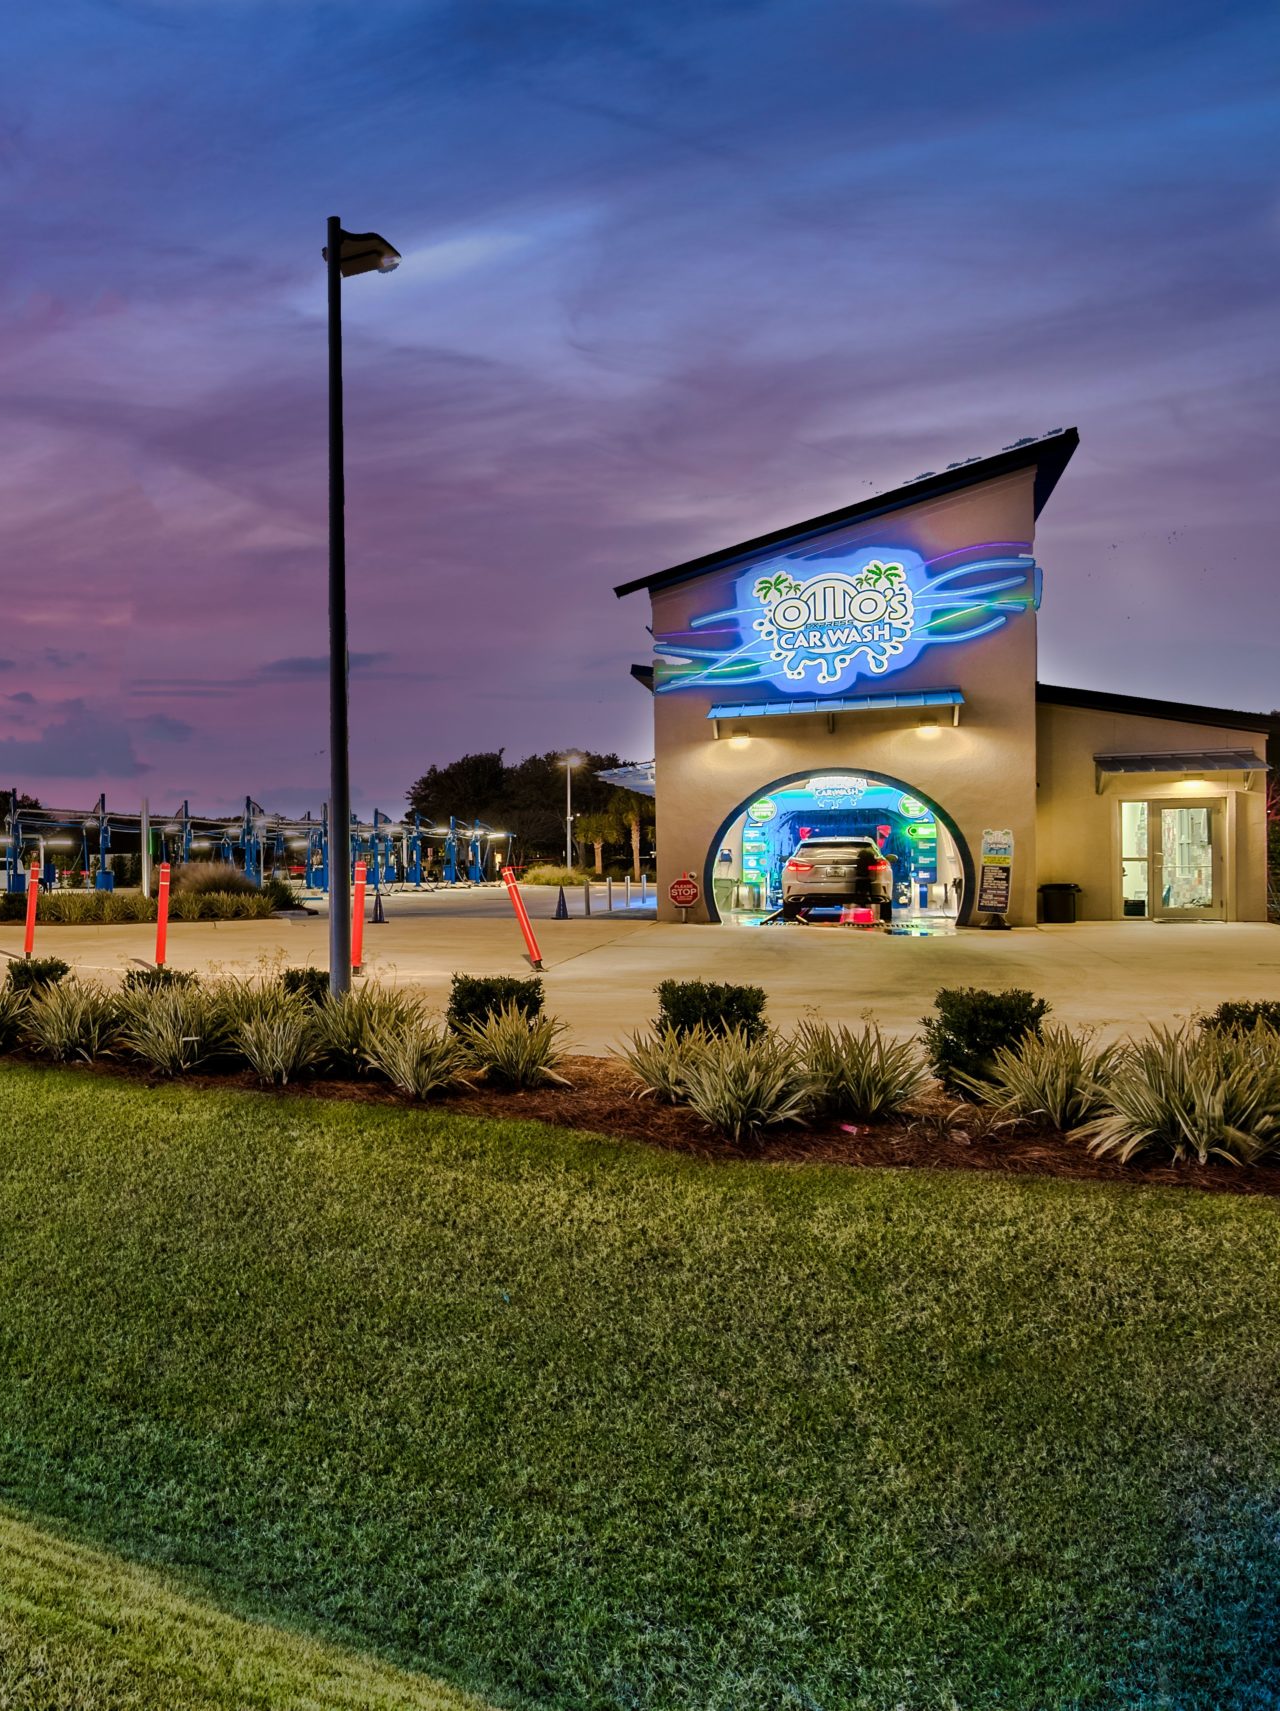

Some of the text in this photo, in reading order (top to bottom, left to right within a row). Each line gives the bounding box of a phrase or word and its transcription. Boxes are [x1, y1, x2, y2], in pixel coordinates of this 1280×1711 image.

[773, 578, 909, 630] OTTO'S
[805, 619, 855, 630] EXPRESS
[780, 623, 891, 650] CAR WASH
[671, 888, 697, 896] STOP
